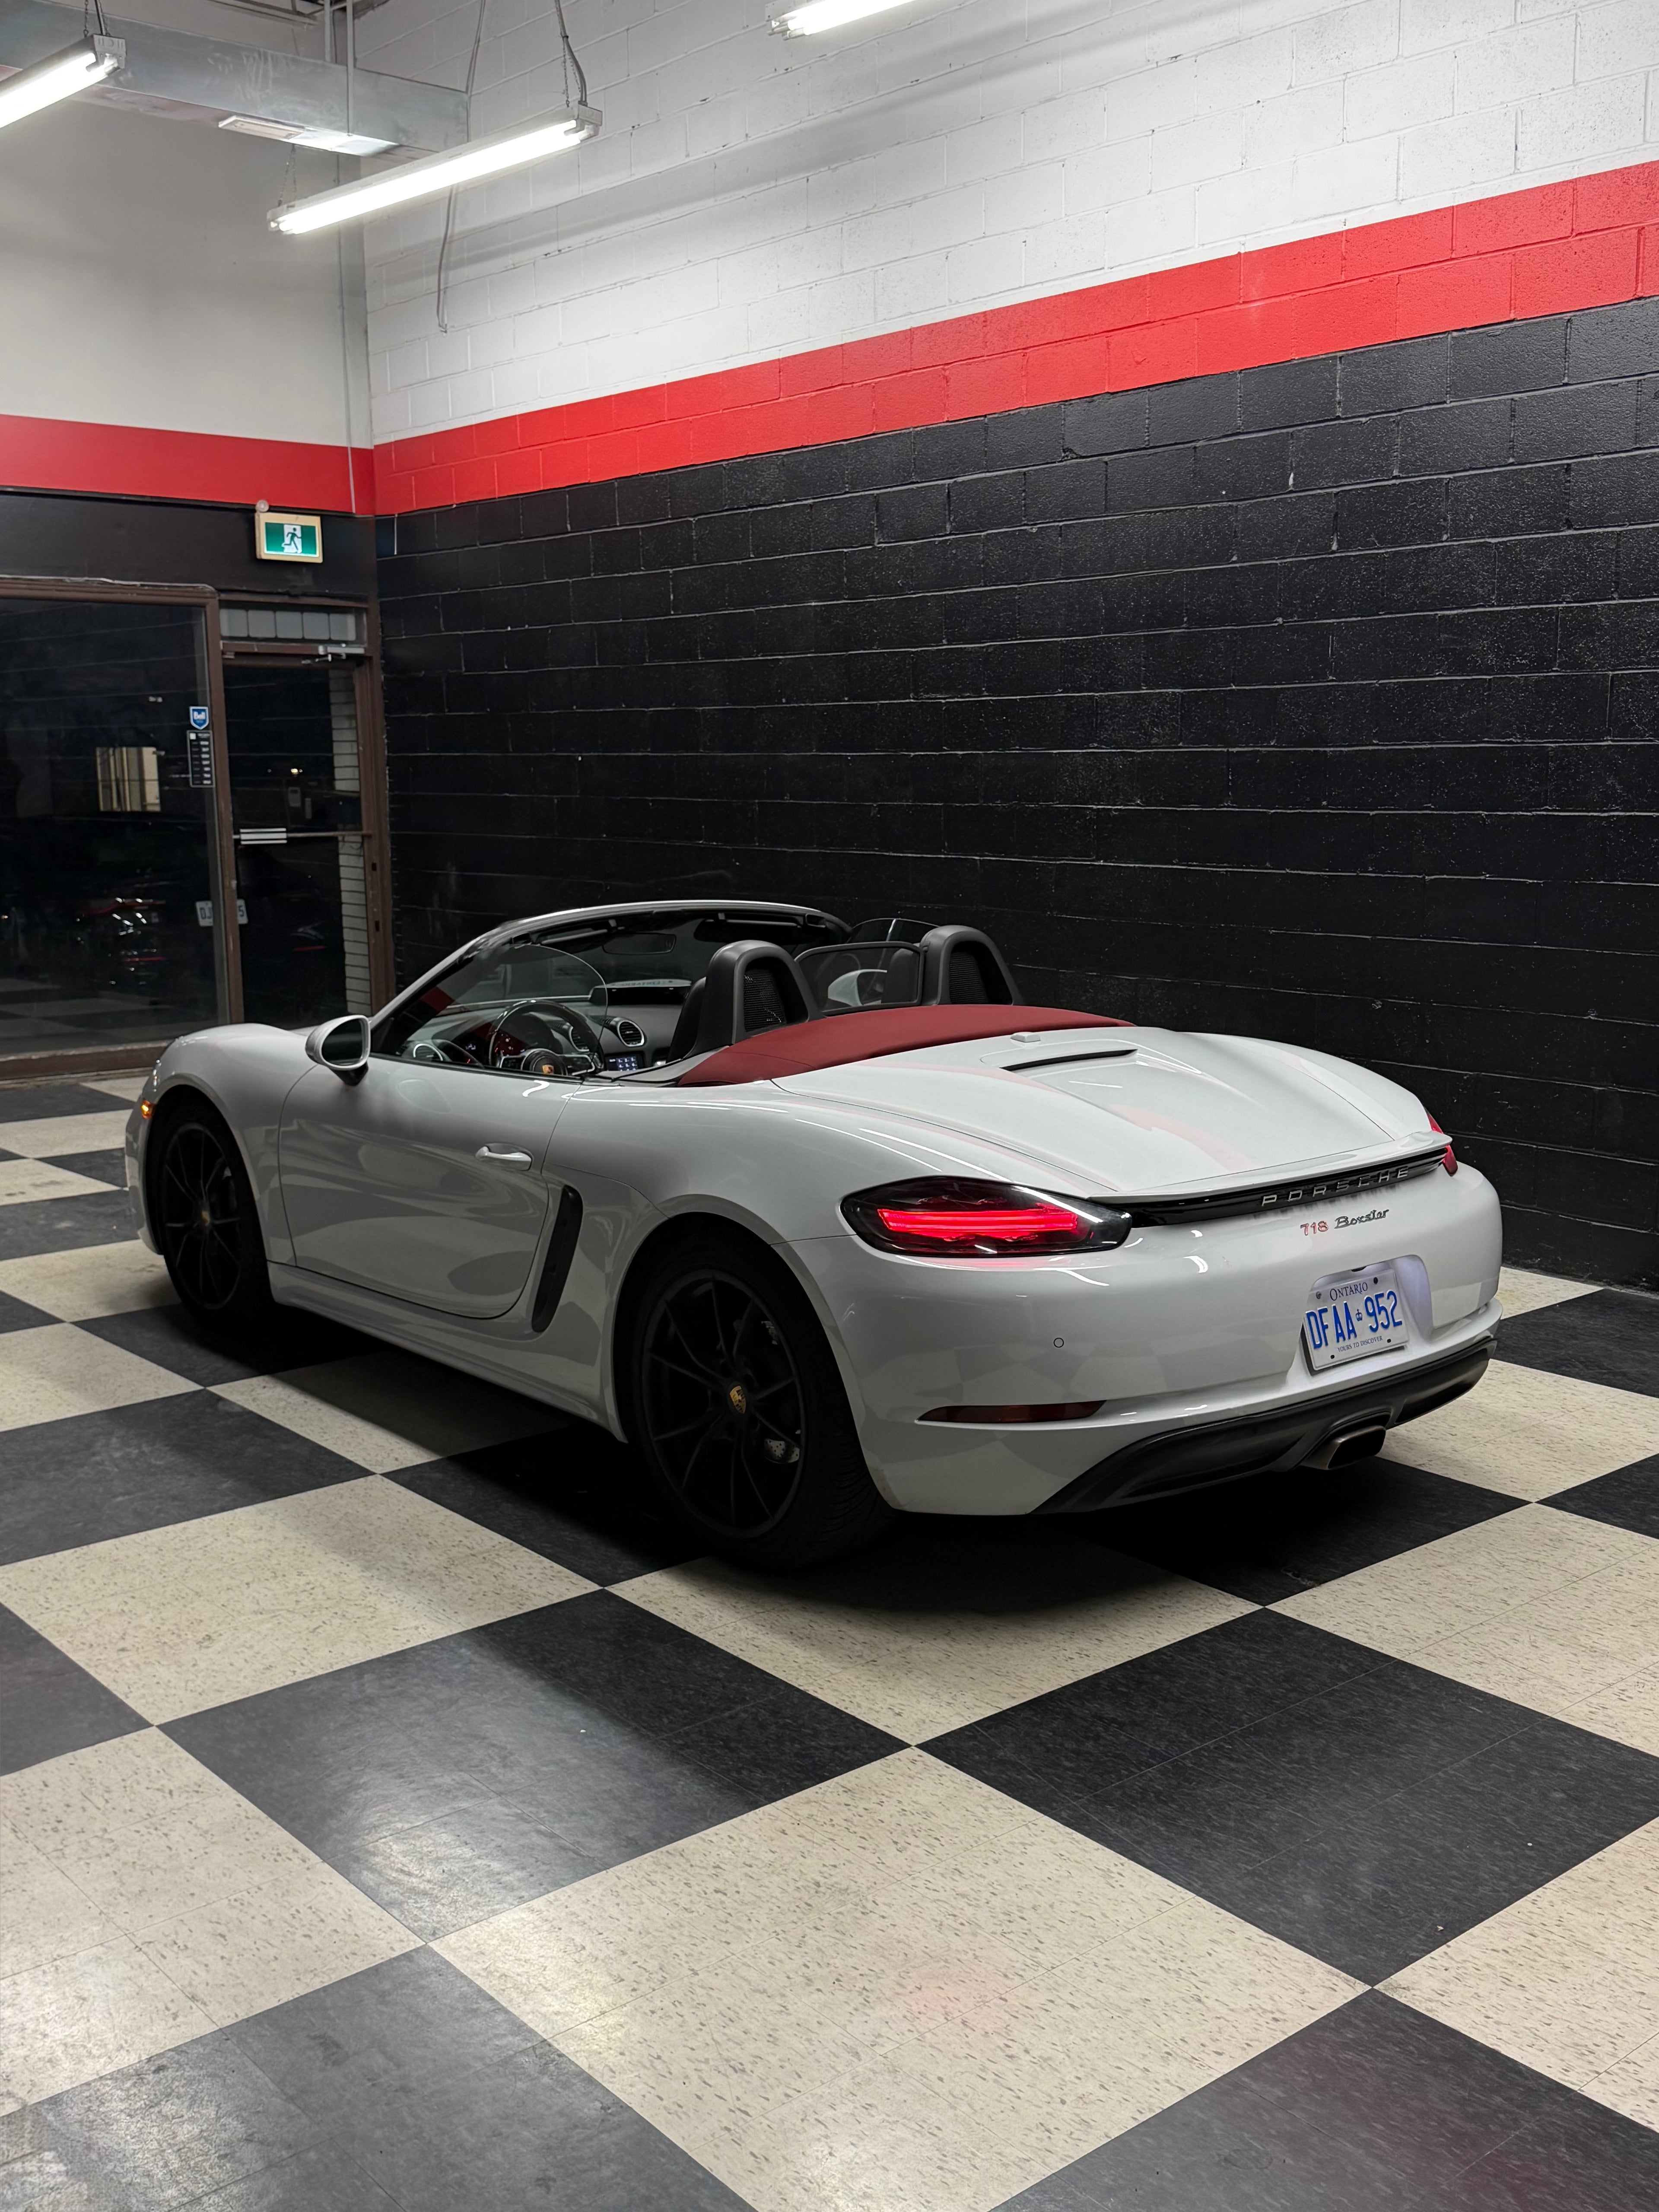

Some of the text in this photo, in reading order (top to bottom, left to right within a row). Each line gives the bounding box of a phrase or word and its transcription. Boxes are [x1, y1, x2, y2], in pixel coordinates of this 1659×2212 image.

[1262, 1167, 1408, 1206] PORSCHE
[1300, 1209, 1389, 1236] 718 Boxster
[1330, 1282, 1368, 1301] ONTARIO
[1306, 1289, 1403, 1350] DFAA 952
[1338, 1344, 1352, 1353] YOURS
[1360, 1335, 1383, 1347] DISCOVER
